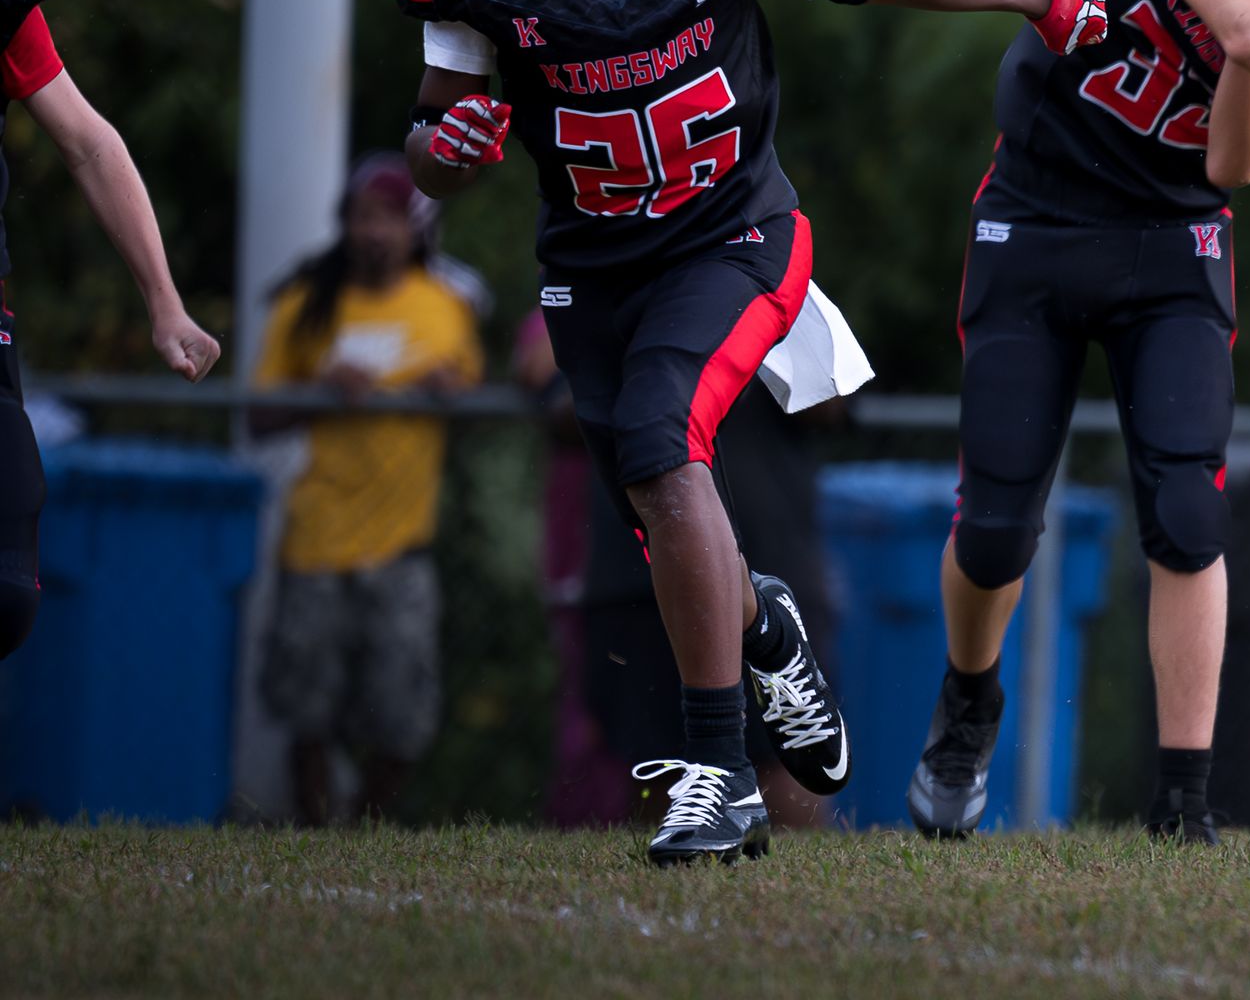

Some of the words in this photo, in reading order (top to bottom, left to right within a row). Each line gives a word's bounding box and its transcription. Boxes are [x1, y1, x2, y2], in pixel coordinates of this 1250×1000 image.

[512, 17, 547, 48] K
[540, 17, 715, 95] KINGSWAY
[555, 66, 741, 219] 26
